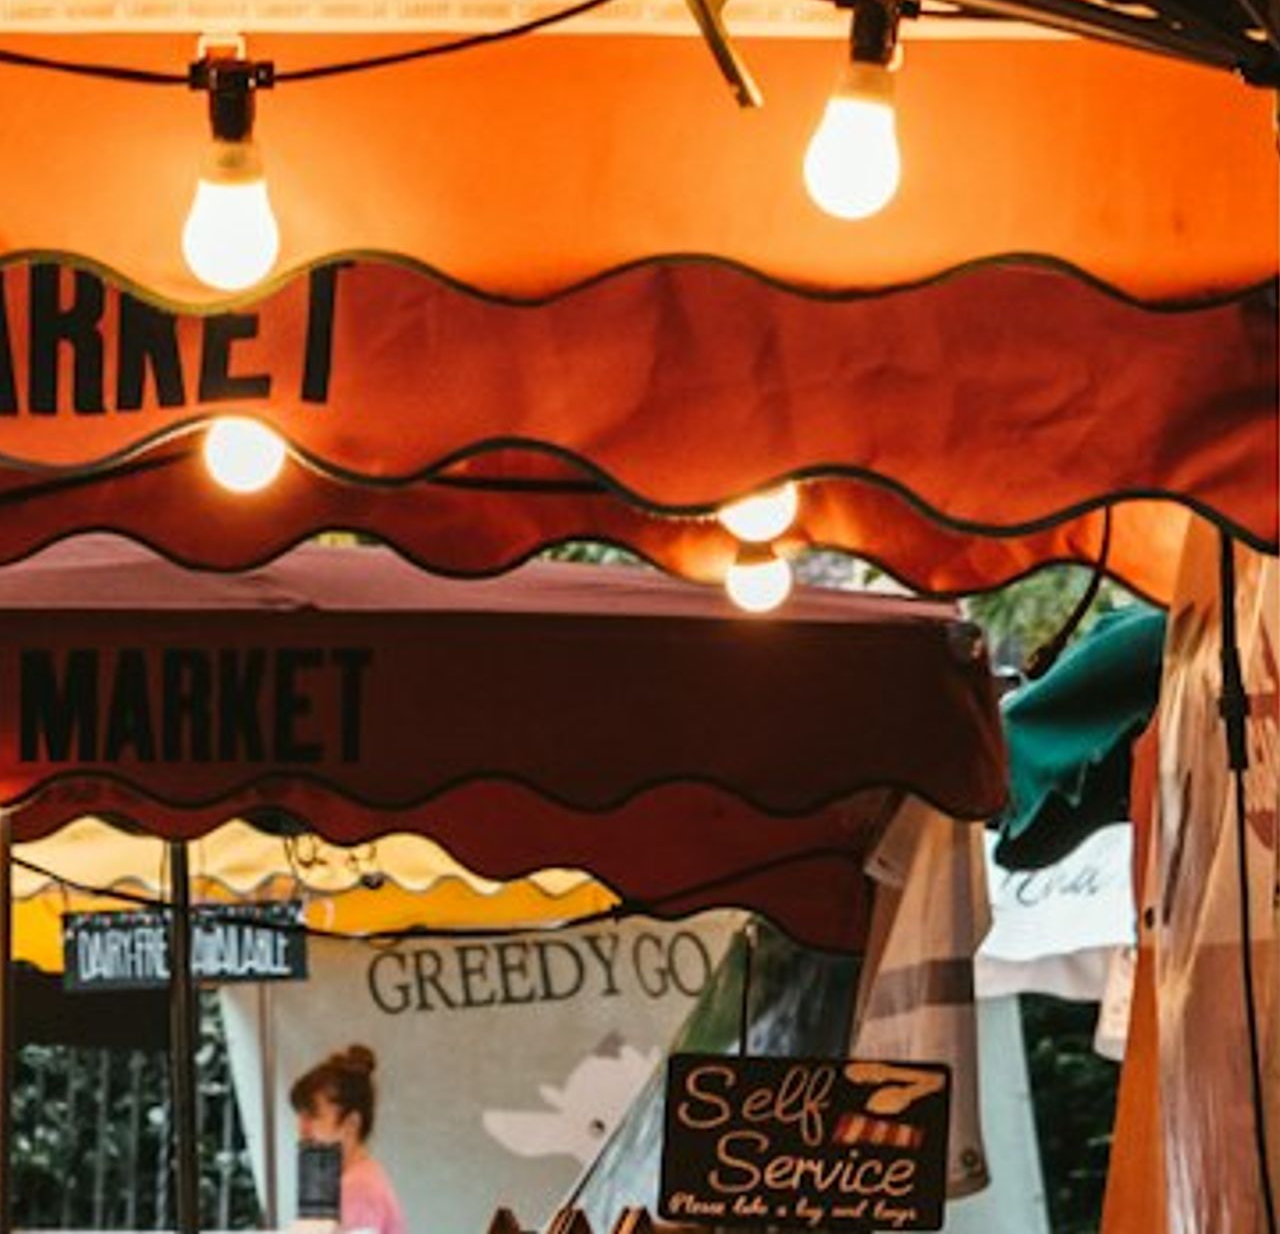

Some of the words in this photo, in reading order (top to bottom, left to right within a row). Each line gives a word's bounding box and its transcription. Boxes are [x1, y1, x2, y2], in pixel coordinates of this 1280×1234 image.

[20, 646, 375, 765] MARKET
[367, 932, 622, 1015] GREEDY
[678, 1064, 837, 1146] Self
[708, 1129, 916, 1197] Service
